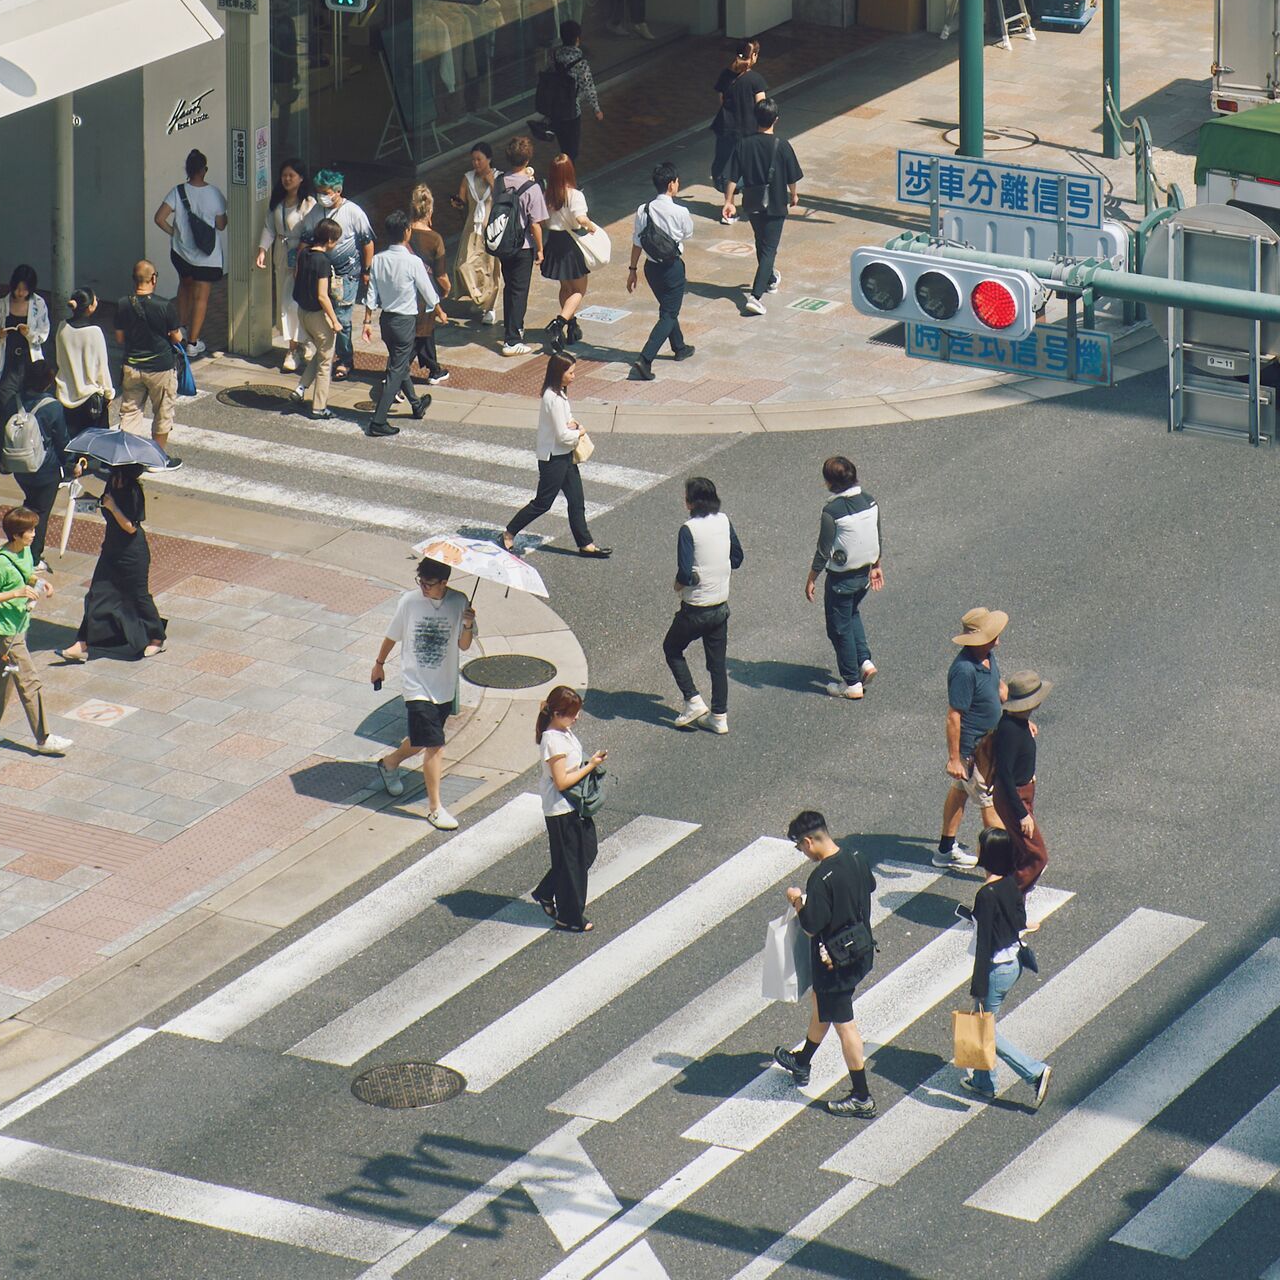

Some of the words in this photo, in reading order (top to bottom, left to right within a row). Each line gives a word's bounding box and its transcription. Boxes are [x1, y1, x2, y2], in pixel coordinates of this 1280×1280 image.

[904, 158, 1094, 219] 歩車分離信号
[914, 322, 1102, 376] 時差式信号機
